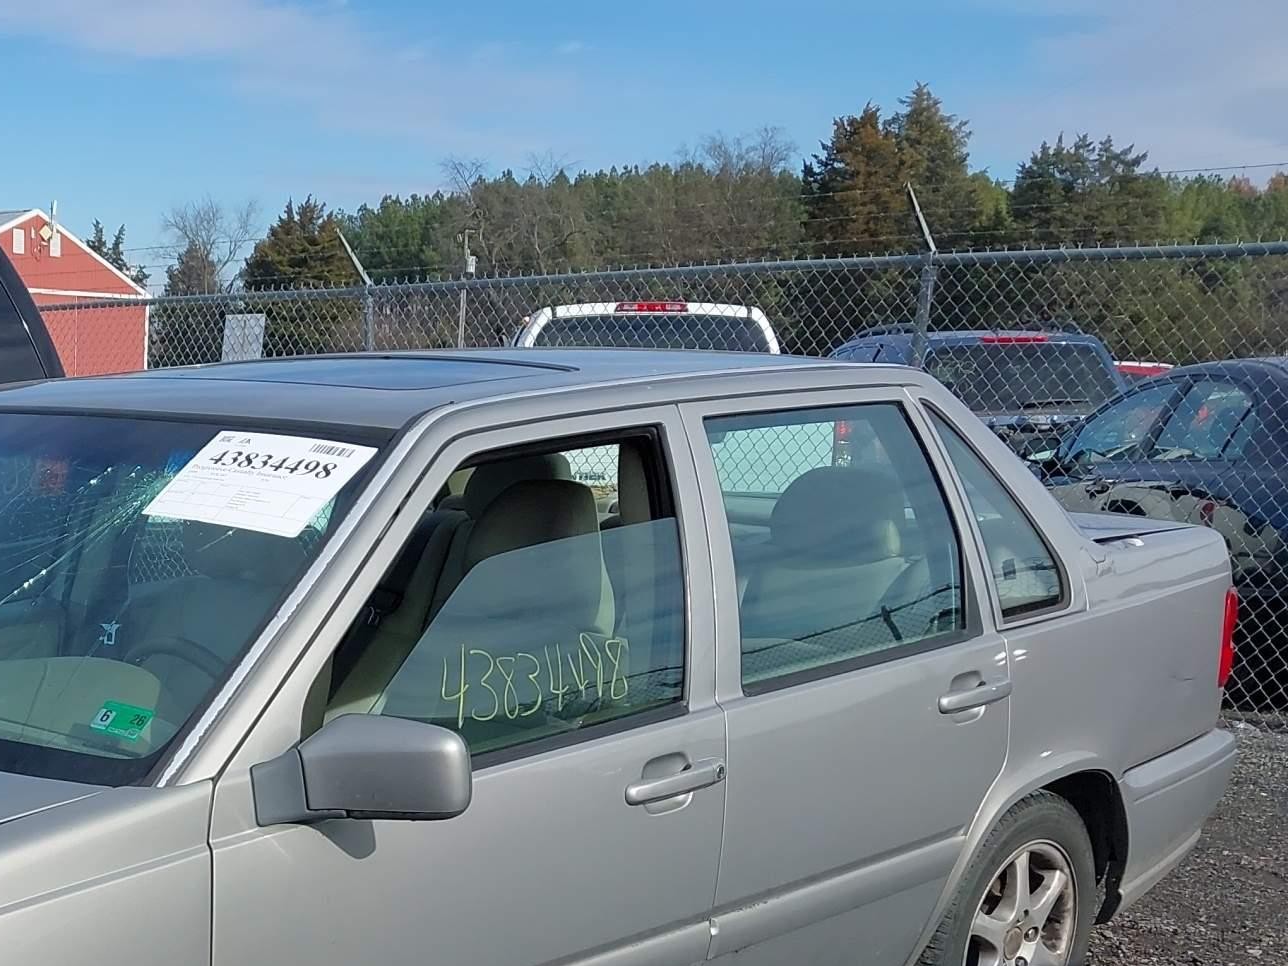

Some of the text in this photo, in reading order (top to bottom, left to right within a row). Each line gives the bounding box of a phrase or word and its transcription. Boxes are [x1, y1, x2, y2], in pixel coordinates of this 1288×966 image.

[209, 450, 338, 479] 43834498
[441, 631, 629, 729] 43834498
[100, 709, 147, 727] 6 26
